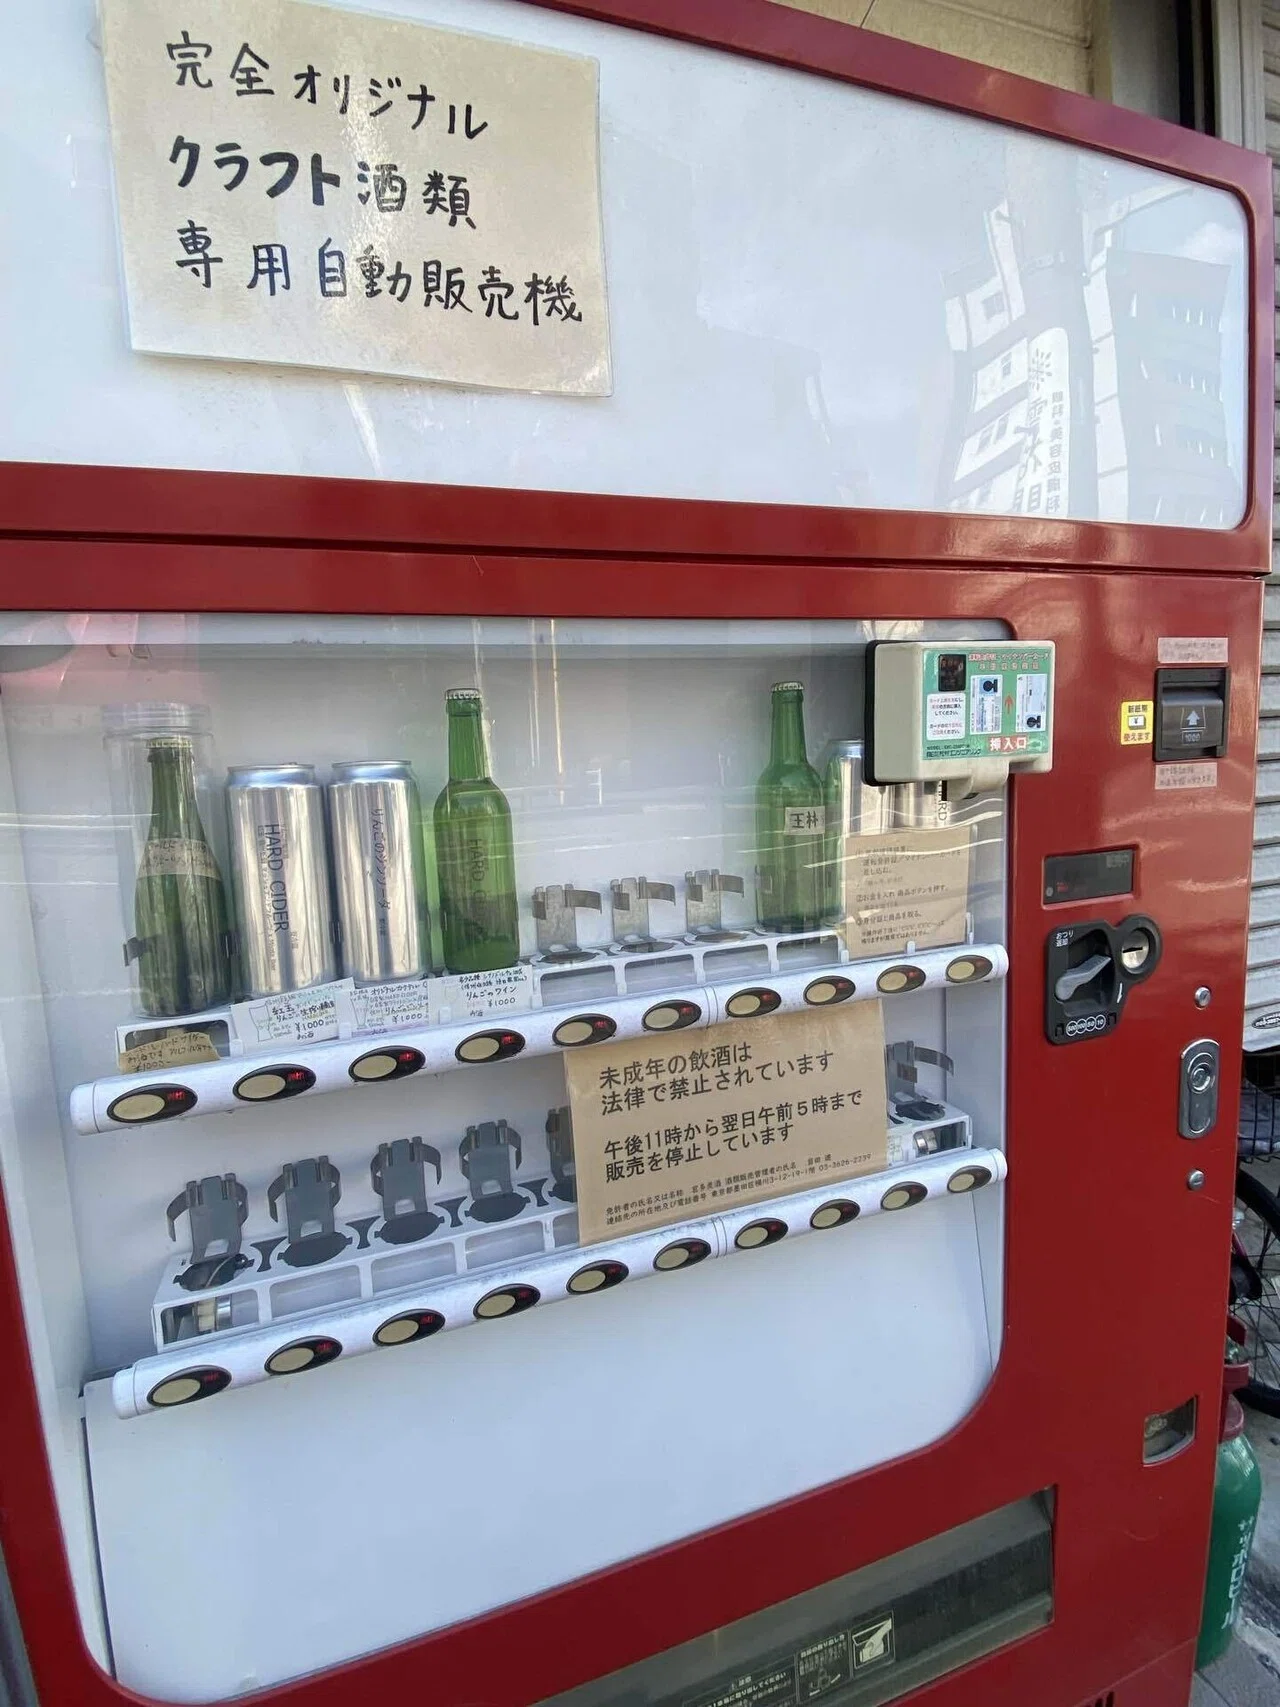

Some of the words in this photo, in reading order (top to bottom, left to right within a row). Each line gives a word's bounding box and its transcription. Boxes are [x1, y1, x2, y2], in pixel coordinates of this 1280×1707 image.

[166, 30, 488, 141] 完全オリジナル
[168, 135, 477, 230] クラフト酒類
[175, 219, 583, 326] 専用自動販売機
[989, 737, 1028, 751] 挿入口
[264, 823, 284, 871] HARD
[270, 879, 290, 933] CIDER
[1056, 930, 1074, 939] おつり
[466, 986, 517, 1001] りんごのワイン
[487, 997, 516, 1007] ¥1000
[295, 1019, 325, 1032] ¥1000
[392, 1013, 423, 1024] ¥1000
[599, 1042, 752, 1090] 未成年の飲酒は
[601, 1050, 834, 1116] 法律で禁止されています
[604, 1090, 863, 1160] 午後11時から翌日午前5時まで
[605, 1122, 794, 1183] 販売を停止しています
